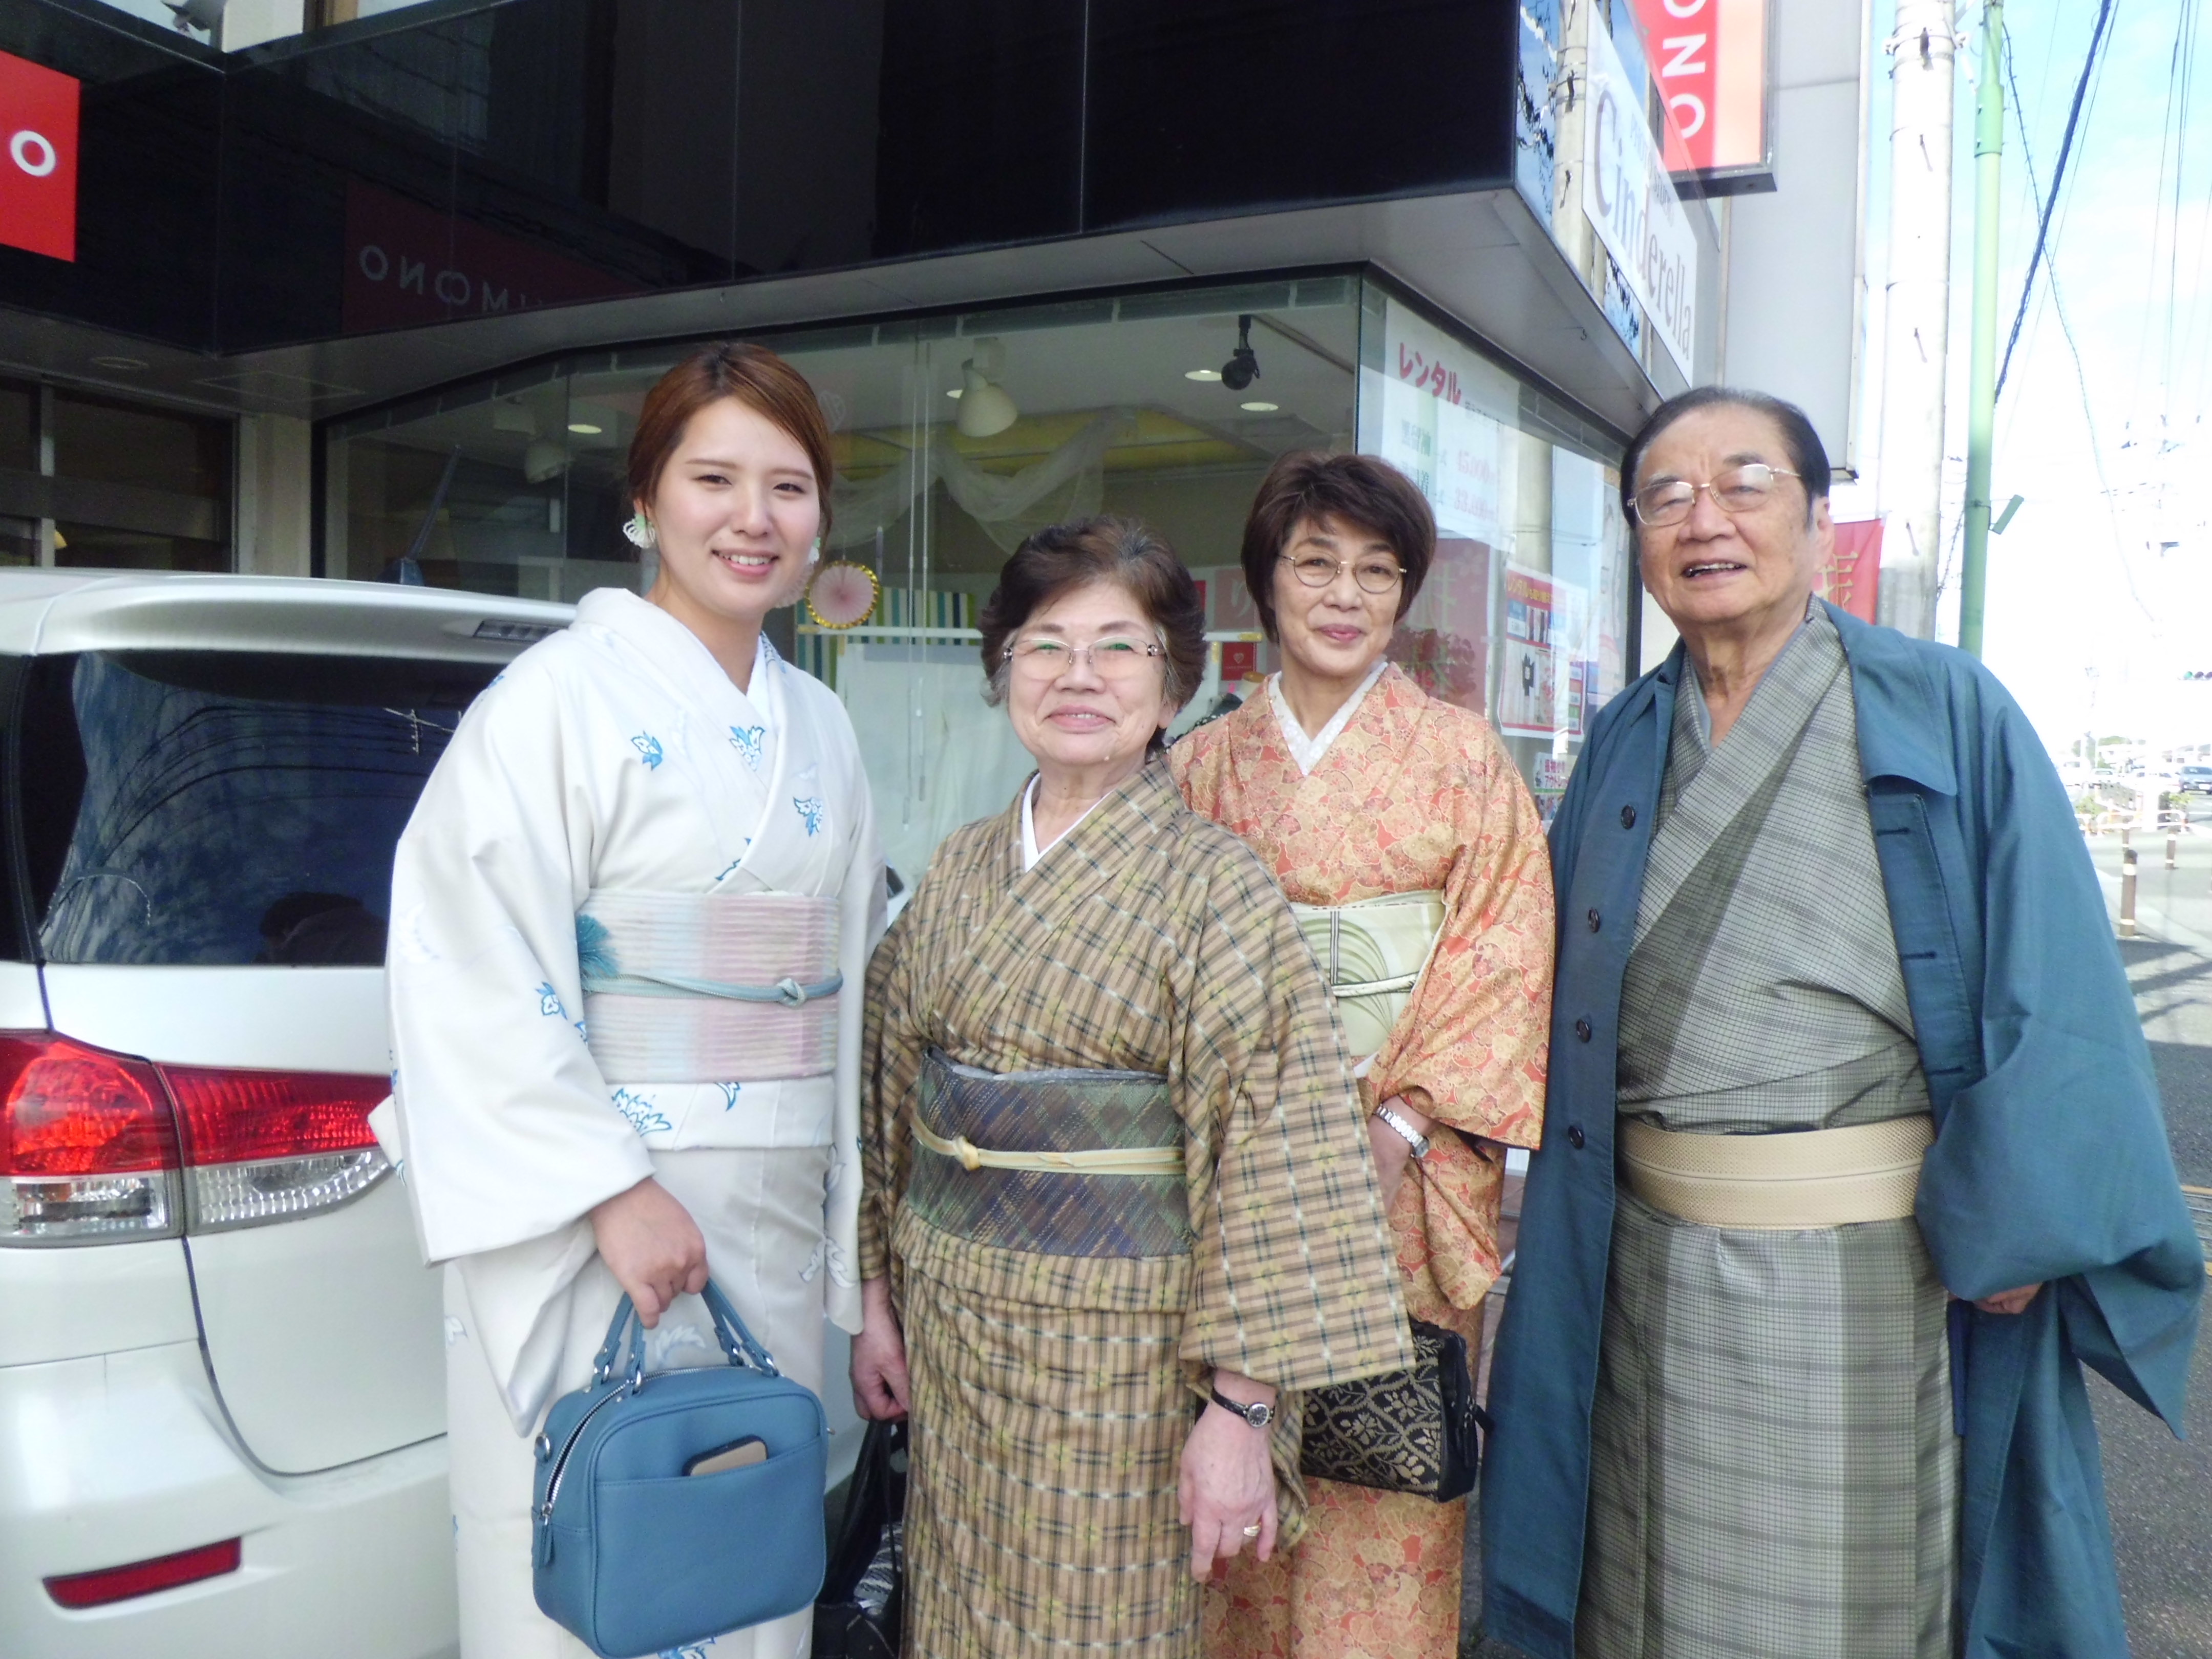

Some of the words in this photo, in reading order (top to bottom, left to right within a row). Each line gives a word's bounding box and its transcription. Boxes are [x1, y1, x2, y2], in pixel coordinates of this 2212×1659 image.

[1594, 90, 1691, 360] Cinderella
[1399, 342, 1461, 405] レンタル
